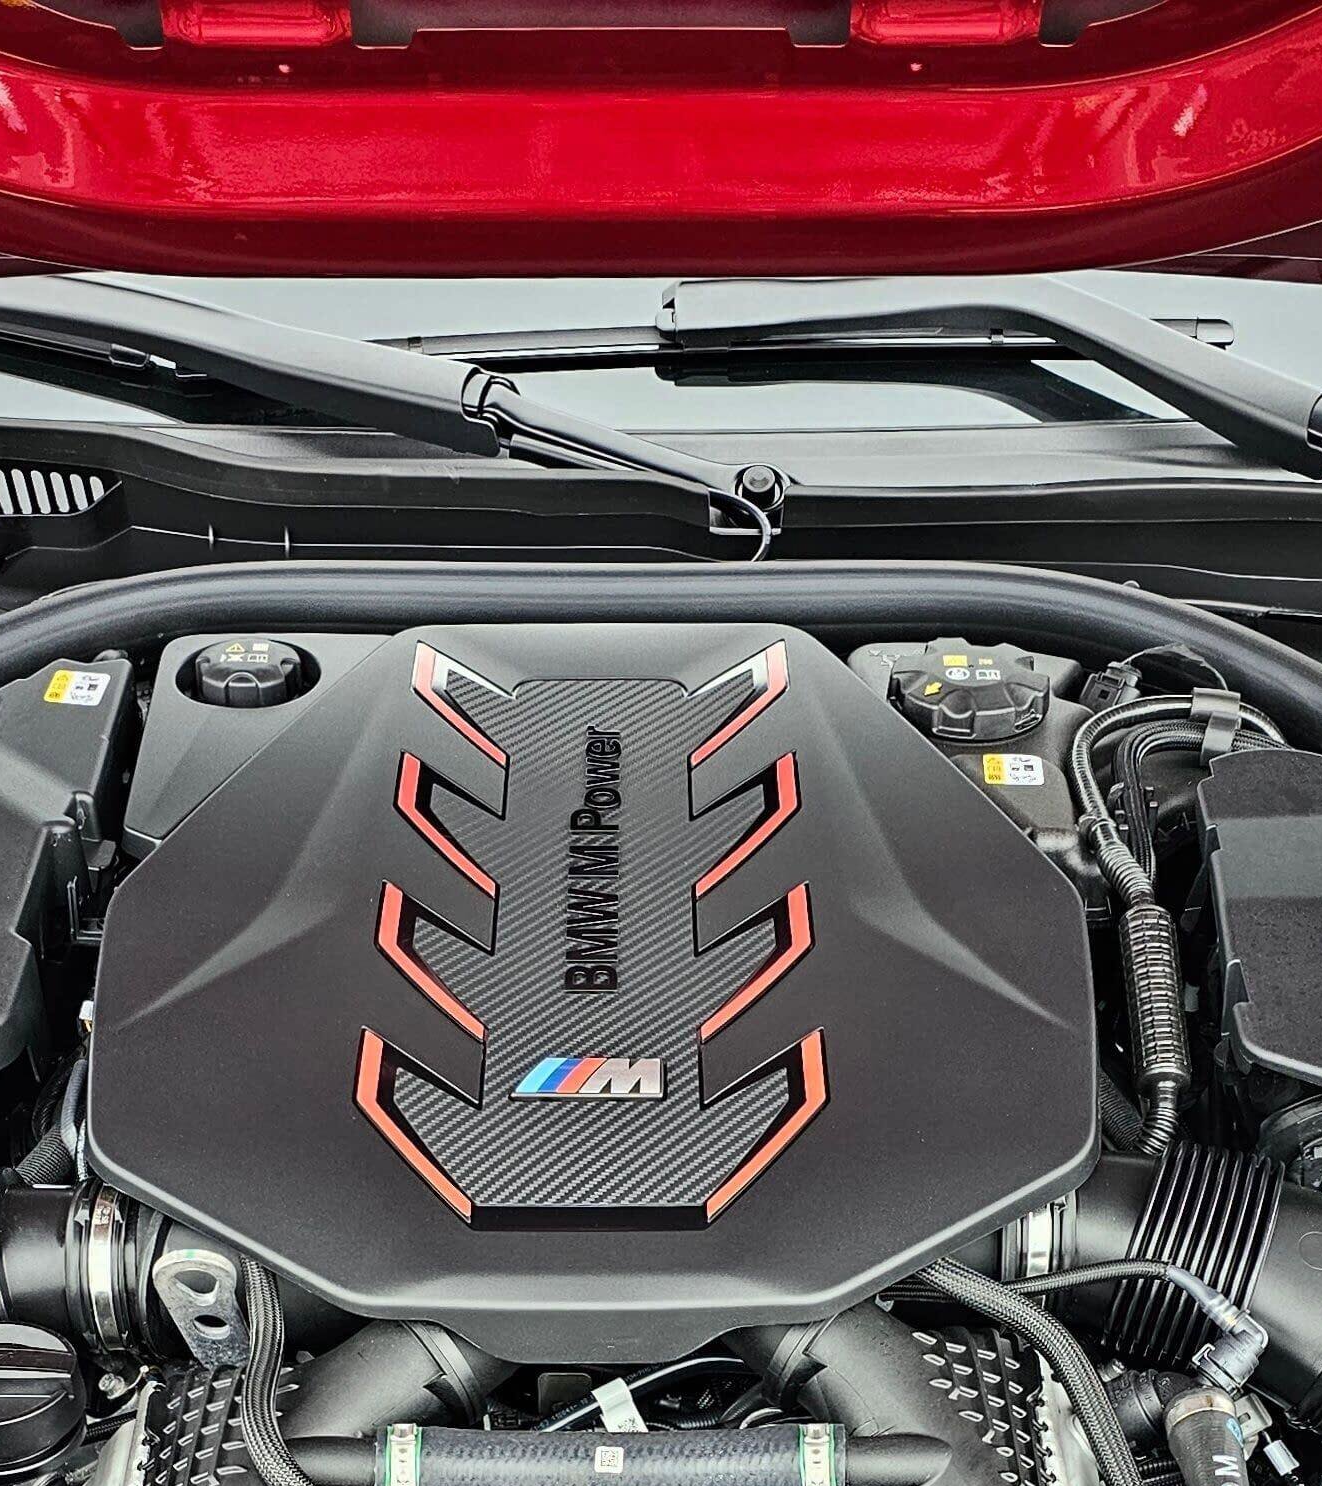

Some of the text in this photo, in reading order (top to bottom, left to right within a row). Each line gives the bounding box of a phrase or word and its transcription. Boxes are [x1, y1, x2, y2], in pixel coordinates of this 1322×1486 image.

[565, 724, 623, 993] BMW M Power
[578, 1057, 662, 1094] M
